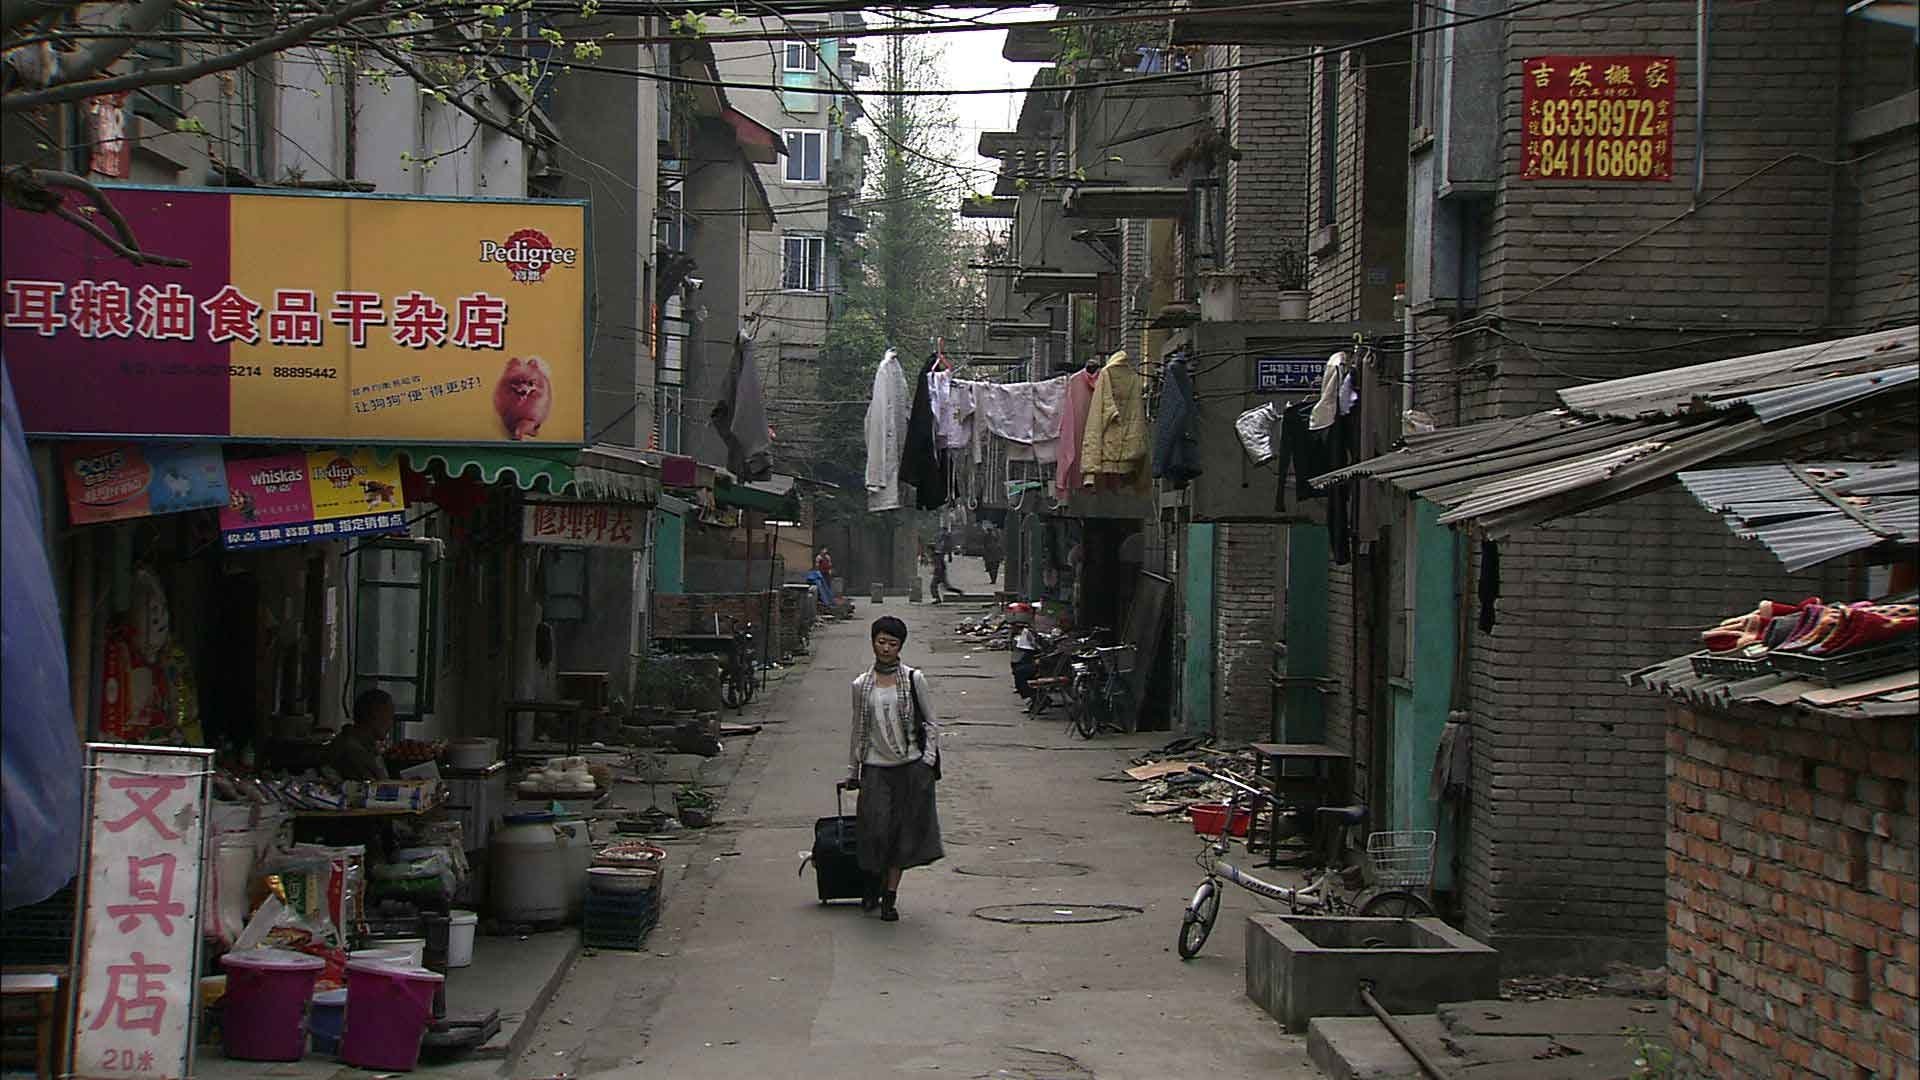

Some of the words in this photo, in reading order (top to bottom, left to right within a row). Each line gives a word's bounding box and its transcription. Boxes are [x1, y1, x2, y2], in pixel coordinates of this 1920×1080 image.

[1542, 100, 1655, 136] 83358972
[1541, 139, 1652, 177] 84116868
[480, 240, 576, 269] Pedigree
[3, 280, 508, 347] 耳粮油食品干杂店
[273, 366, 337, 379] 88895442
[250, 469, 304, 486] whiskas
[89, 775, 187, 1037] 文具店
